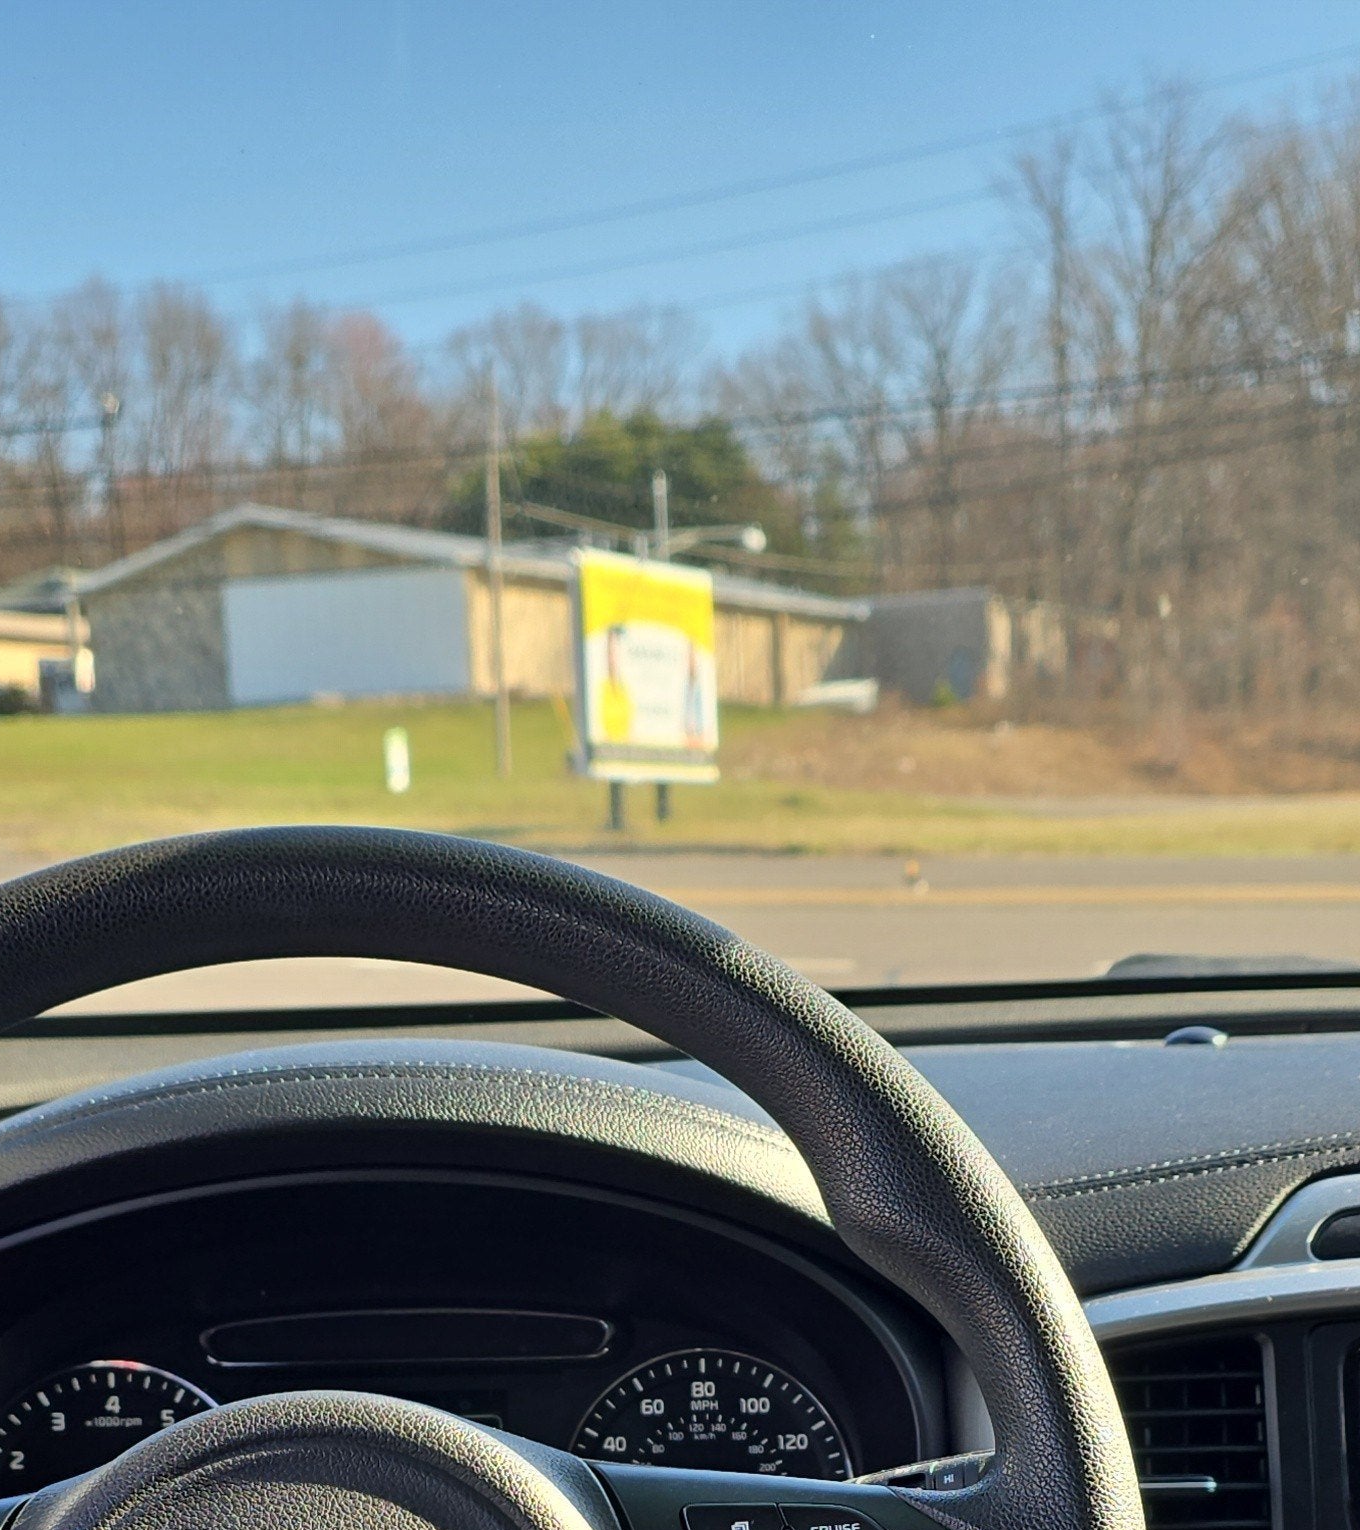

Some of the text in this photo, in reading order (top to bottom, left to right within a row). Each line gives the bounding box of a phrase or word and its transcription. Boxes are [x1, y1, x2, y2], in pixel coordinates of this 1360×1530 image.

[691, 1381, 716, 1398] 80
[104, 1394, 121, 1414] 4
[640, 1398, 665, 1415] 60
[690, 1400, 719, 1411] MPH
[740, 1397, 770, 1414] 100
[51, 1411, 66, 1432] 3
[159, 1408, 176, 1428] 5
[603, 1436, 627, 1452] 40
[777, 1433, 809, 1451] 120
[9, 1450, 25, 1471] 2
[943, 1474, 954, 1484] HI
